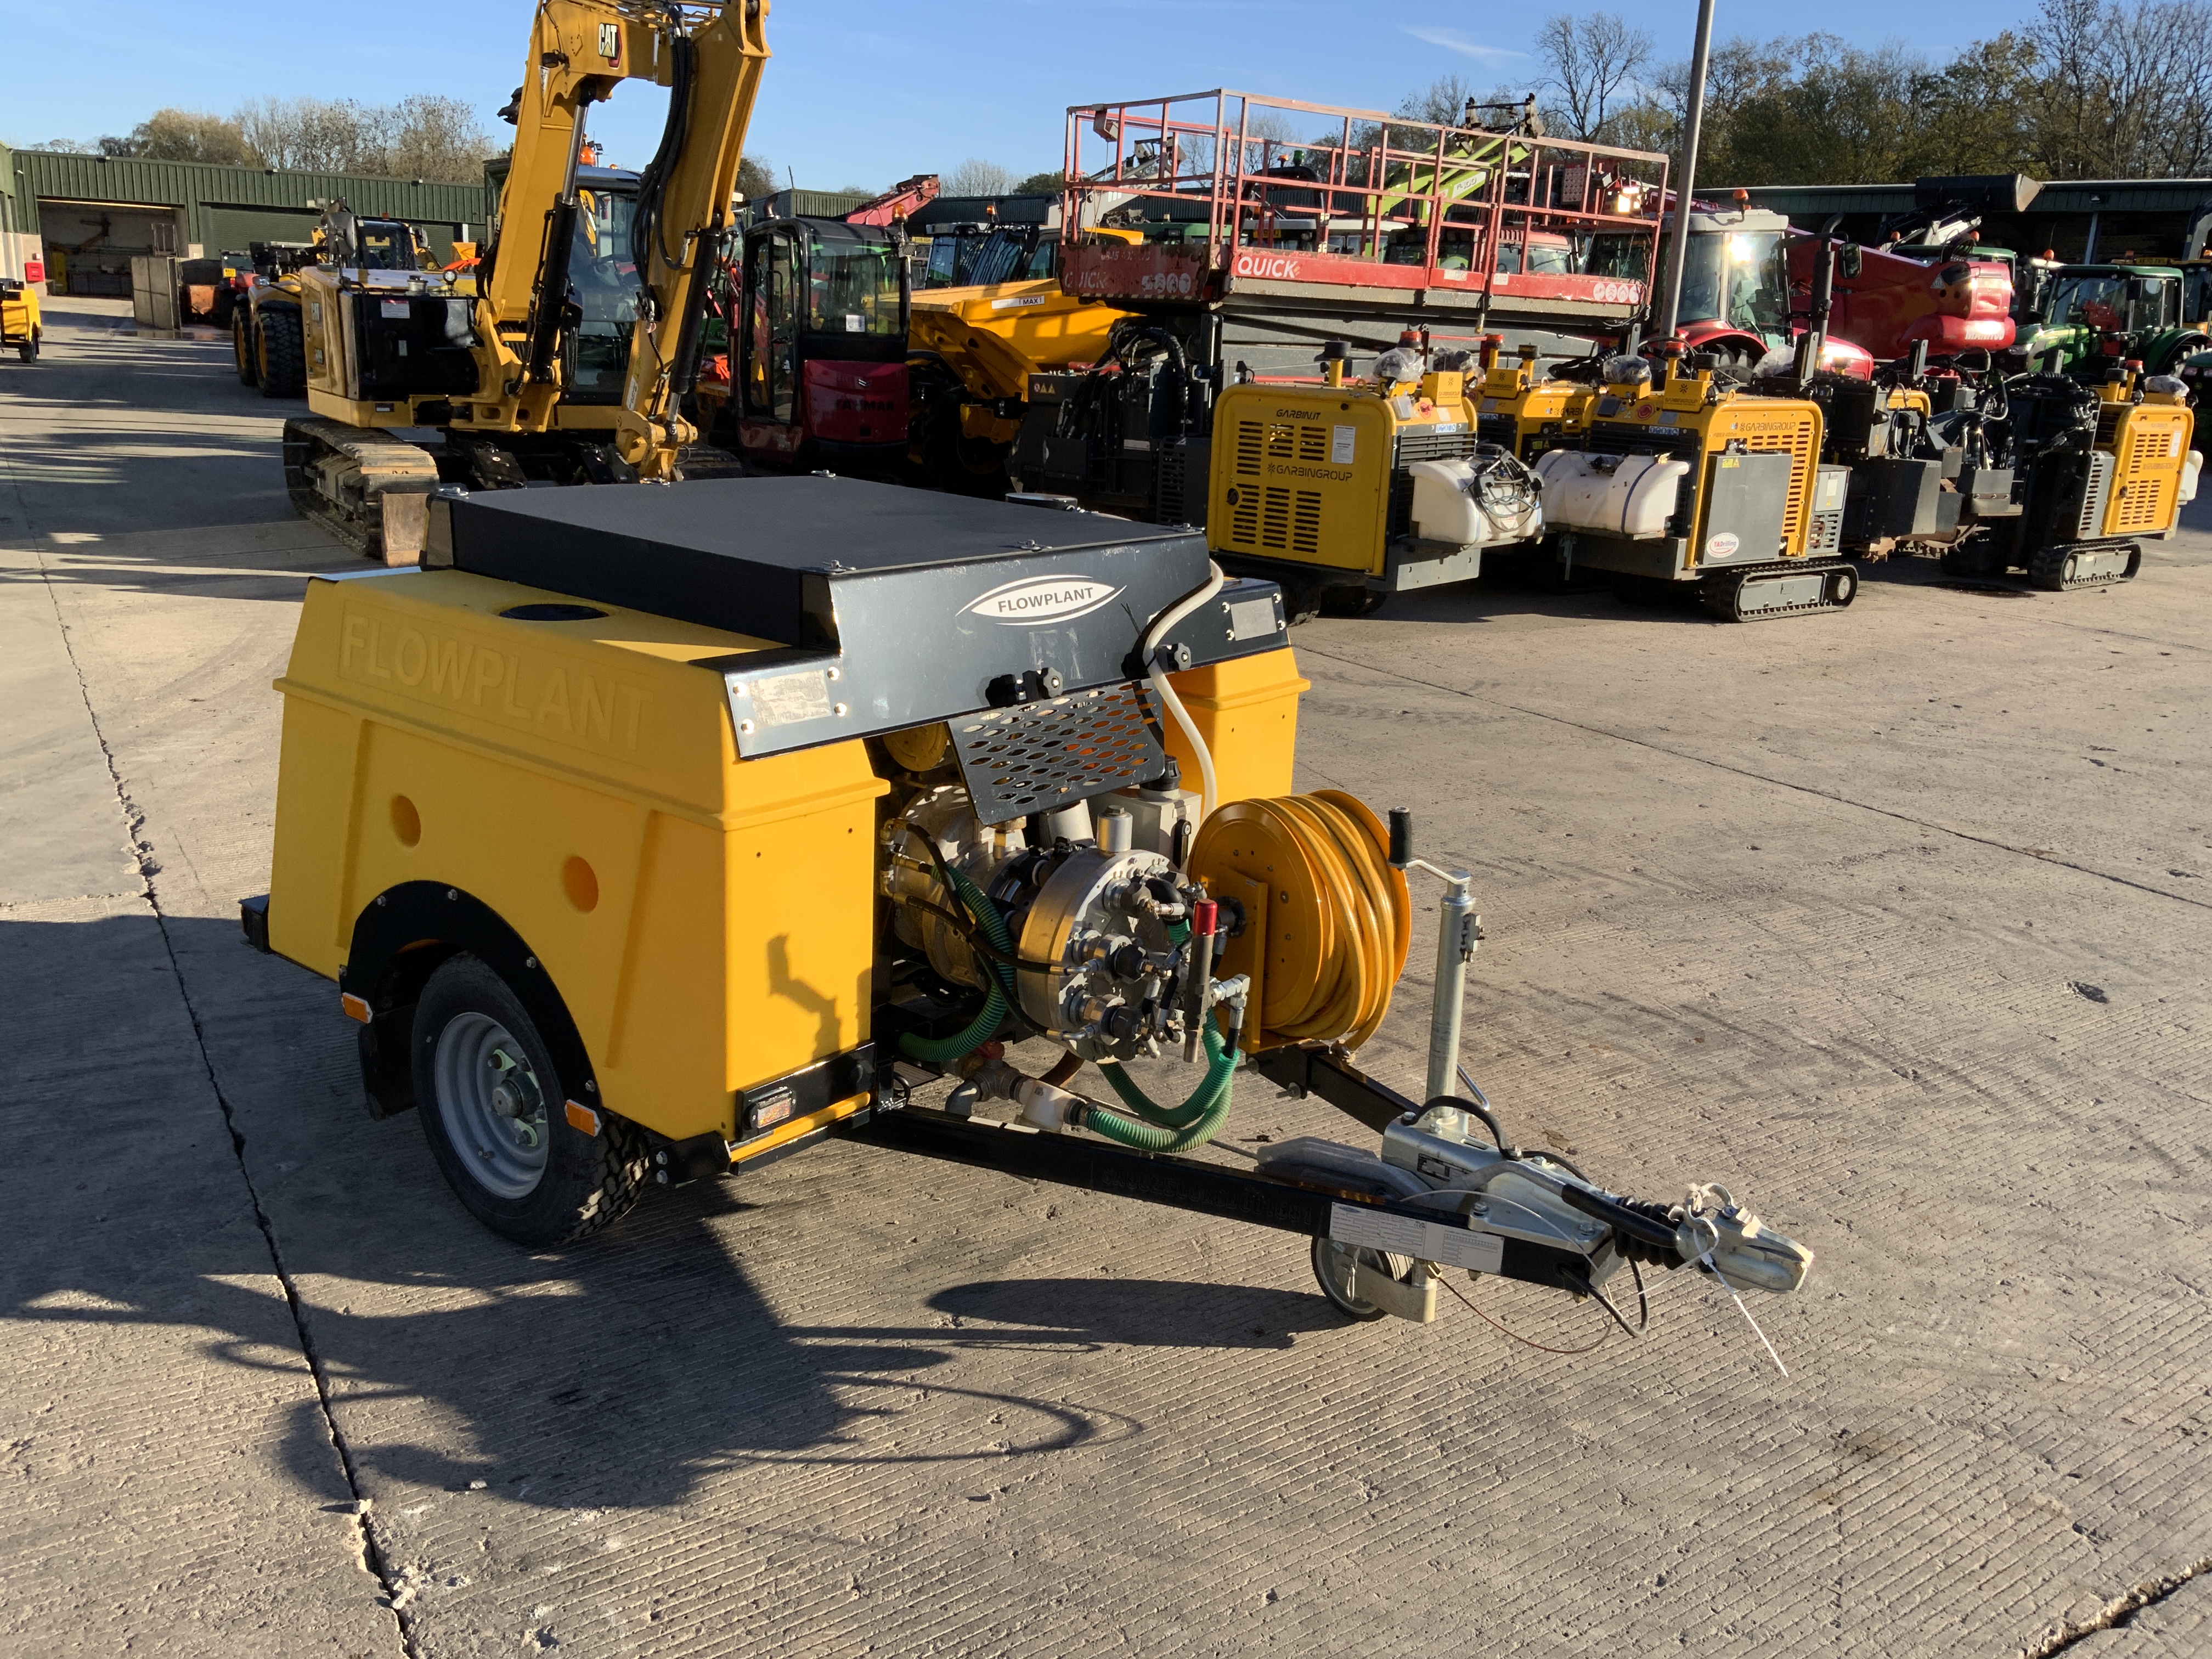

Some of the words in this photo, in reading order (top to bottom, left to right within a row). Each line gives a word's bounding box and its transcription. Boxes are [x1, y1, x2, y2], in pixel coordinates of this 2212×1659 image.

[599, 23, 617, 58] CAT
[1238, 256, 1299, 278] QUICK
[1276, 409, 1321, 421] GARBIN.IT
[1746, 422, 1796, 431] GARBINGROUP
[1277, 465, 1352, 481] GARBINGROUP
[997, 587, 1093, 613] FLOWPLANT
[340, 613, 655, 751] FLOWPLANT
